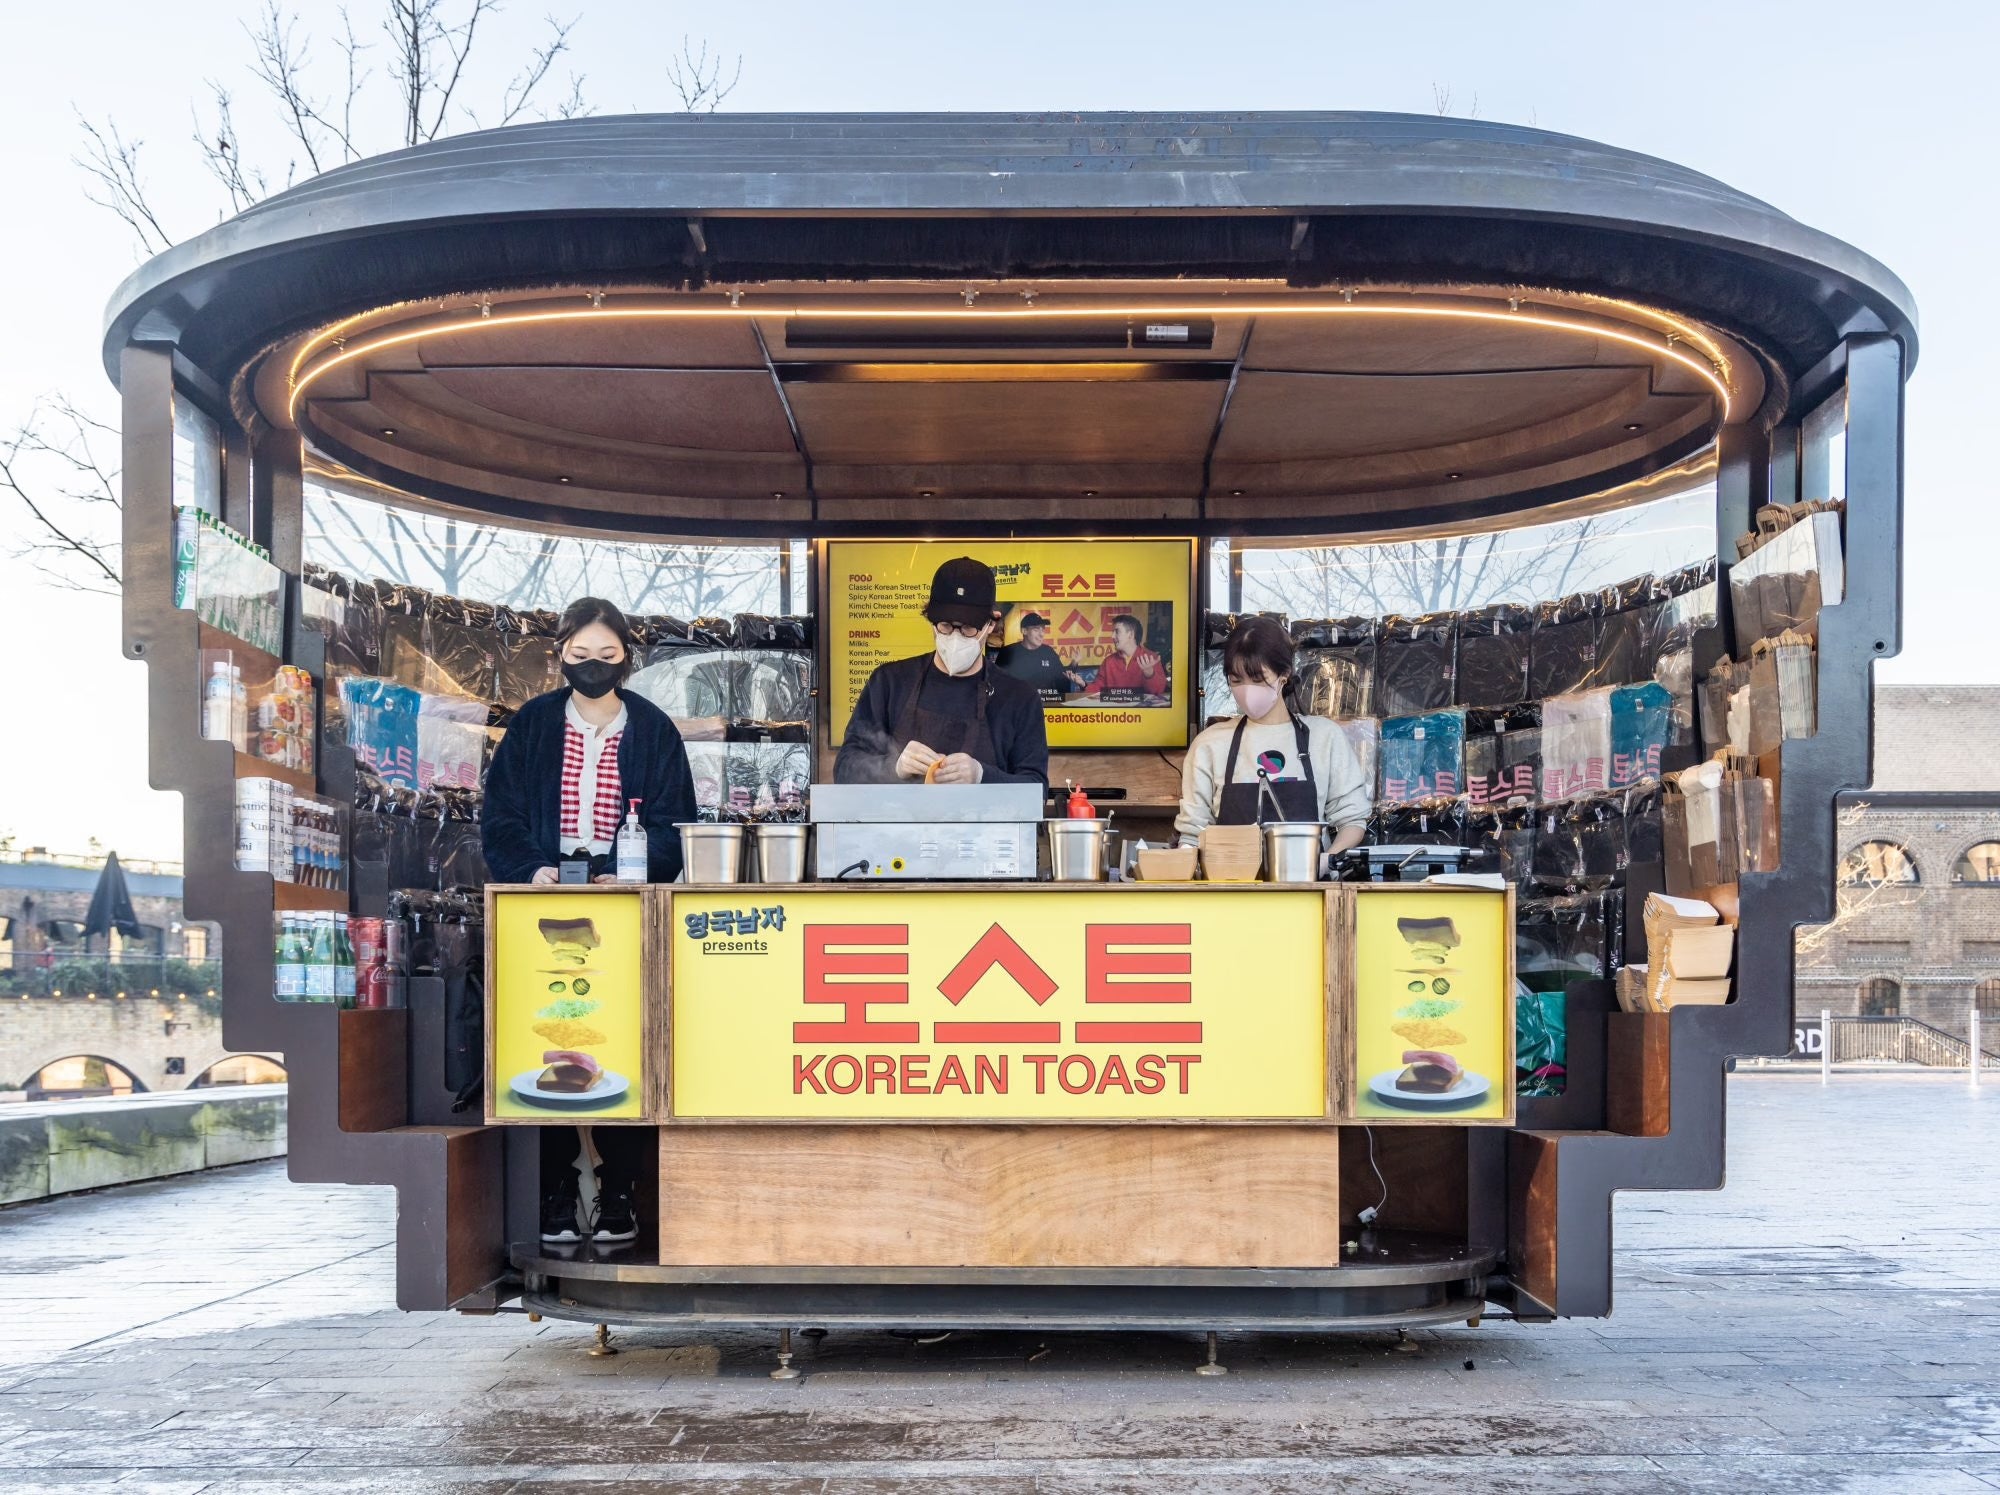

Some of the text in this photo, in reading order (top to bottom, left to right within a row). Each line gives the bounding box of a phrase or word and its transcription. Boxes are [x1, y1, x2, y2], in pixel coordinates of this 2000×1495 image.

[848, 574, 873, 582] FOOD
[1041, 574, 1117, 598] 토스트
[848, 593, 867, 601] Spicy
[848, 602, 919, 610] Kimchi Cheese Toast
[848, 631, 881, 639] DRINKS
[849, 687, 861, 695] Spa
[1467, 765, 1536, 805] 토스트
[1543, 757, 1604, 799] 토스트
[685, 904, 787, 939] 영국남자
[702, 939, 768, 953] presents
[793, 922, 1203, 1044] 토스트
[793, 1054, 1202, 1095] KOREAN TOAST
